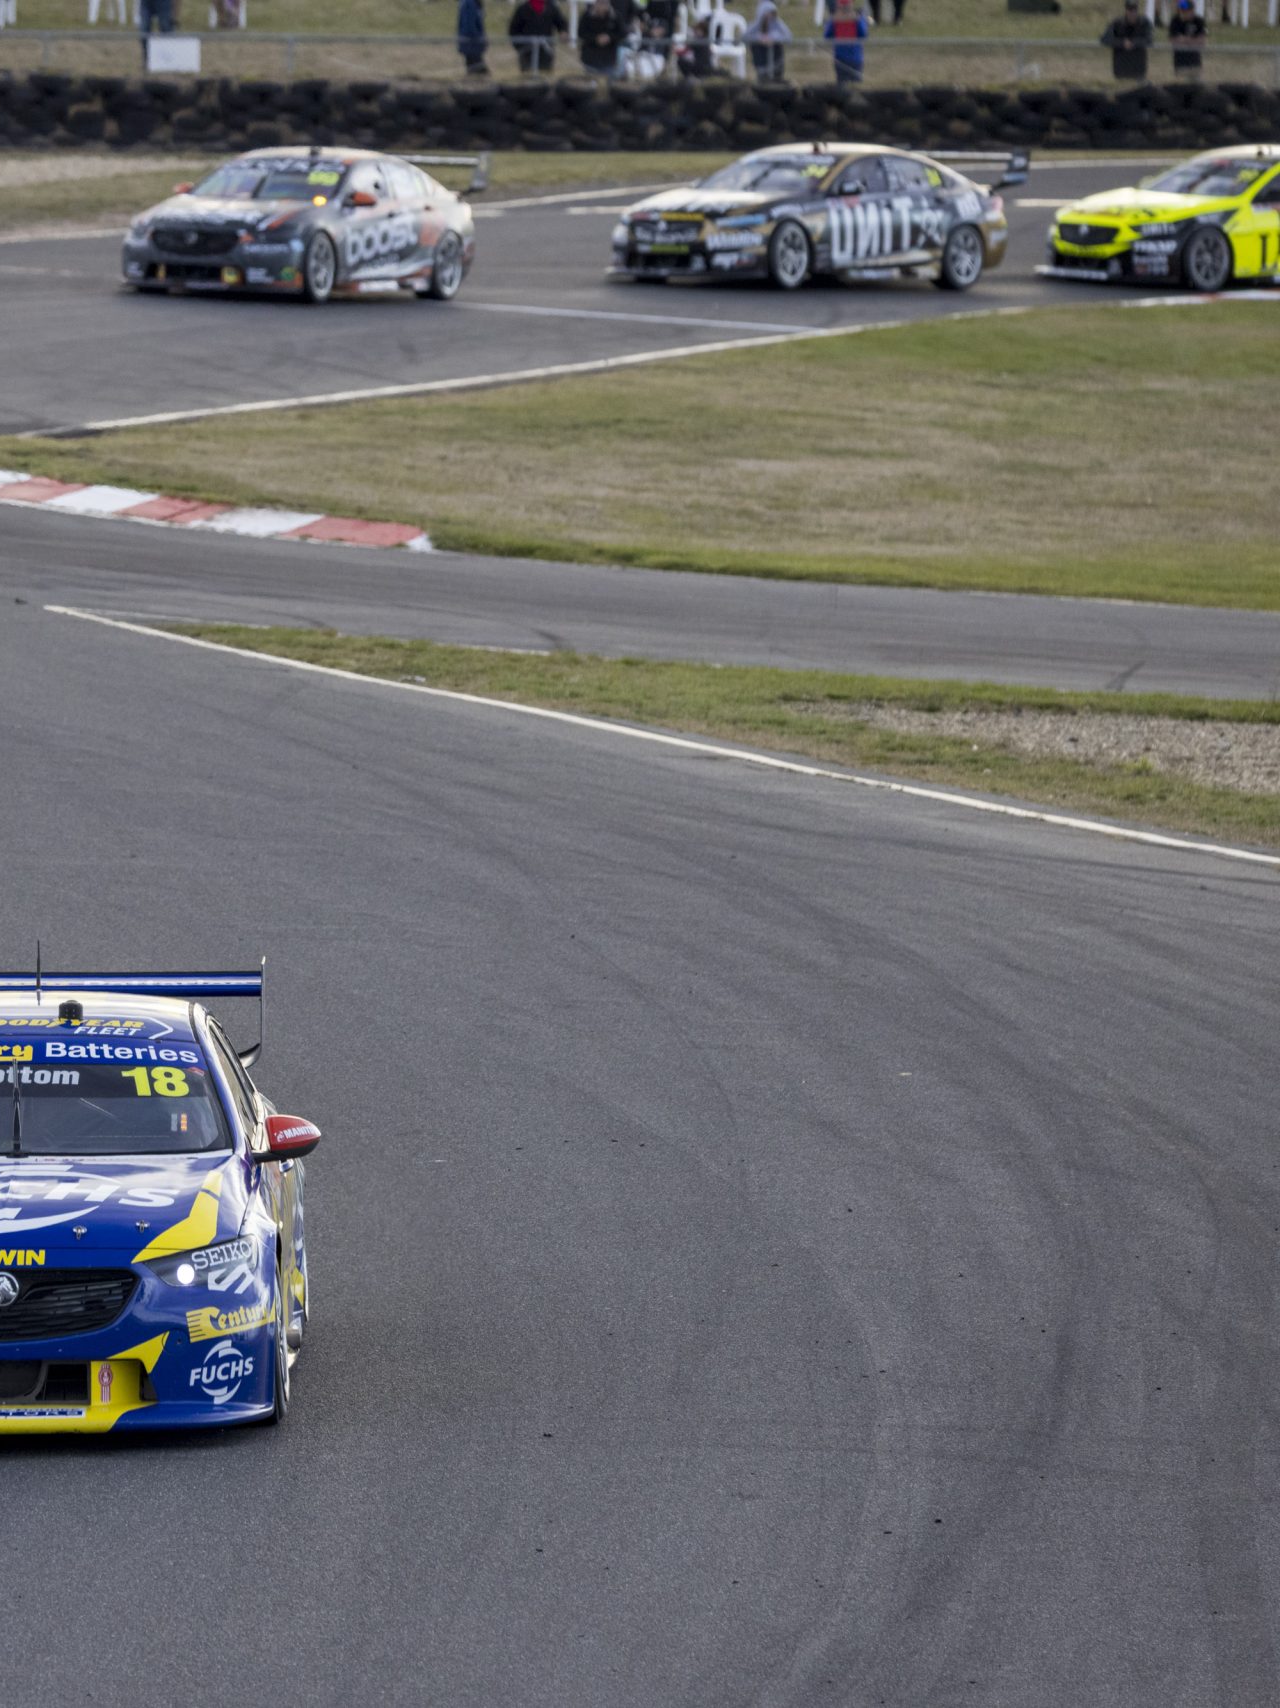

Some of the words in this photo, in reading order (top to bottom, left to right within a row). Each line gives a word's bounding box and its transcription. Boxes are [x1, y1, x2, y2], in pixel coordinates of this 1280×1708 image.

[74, 1026, 142, 1036] FLEET
[45, 1041, 199, 1064] Batteries
[121, 1066, 190, 1098] 18
[191, 1241, 253, 1271] SEIKO
[189, 1356, 255, 1387] FUCHS
